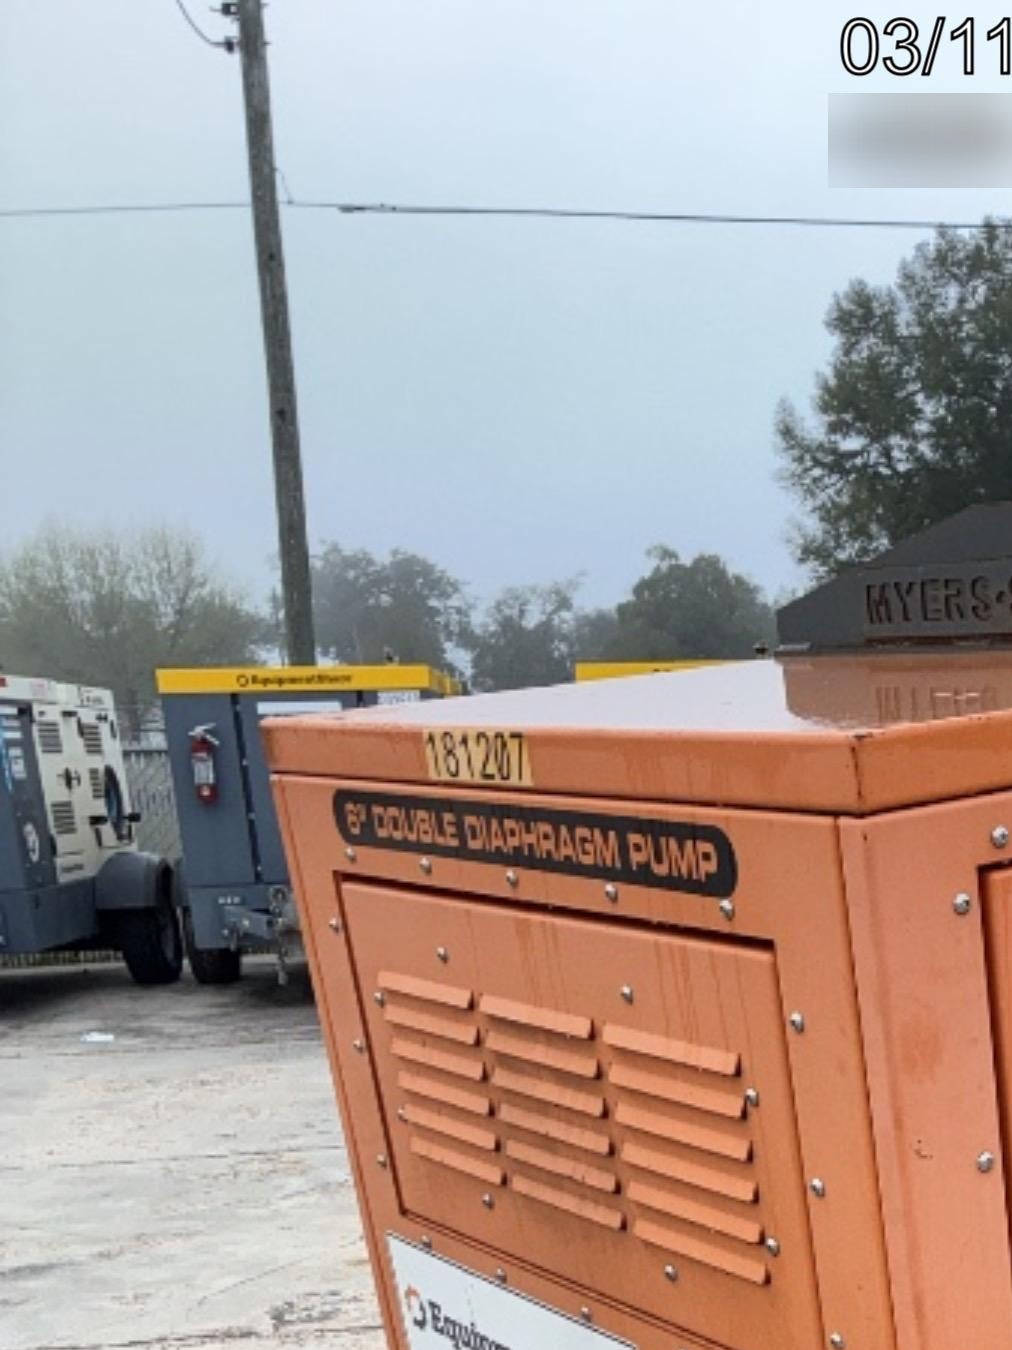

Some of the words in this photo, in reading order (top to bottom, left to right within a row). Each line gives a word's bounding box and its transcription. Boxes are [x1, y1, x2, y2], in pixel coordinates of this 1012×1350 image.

[426, 731, 524, 782] 181207
[372, 806, 460, 848] DOUBLE
[463, 815, 623, 870] DIAPHRAGM
[626, 833, 719, 883] PUMP
